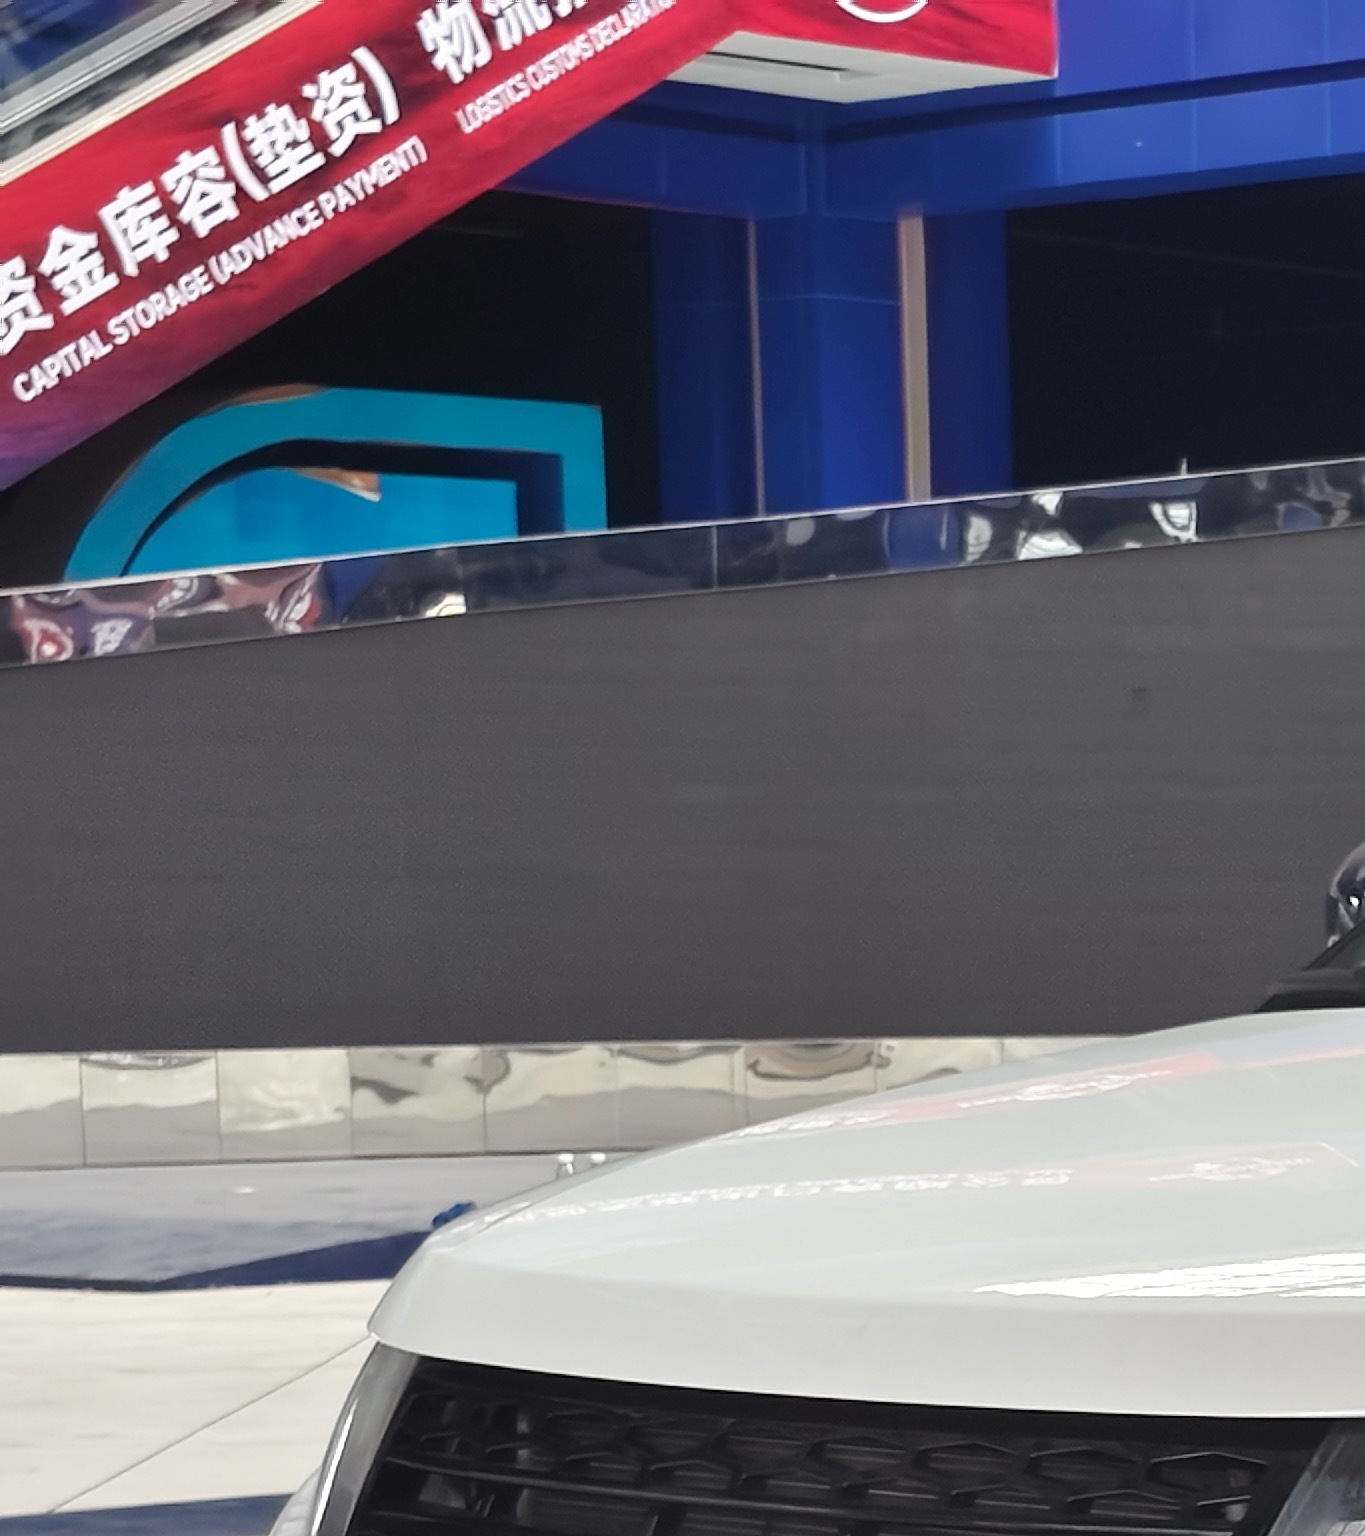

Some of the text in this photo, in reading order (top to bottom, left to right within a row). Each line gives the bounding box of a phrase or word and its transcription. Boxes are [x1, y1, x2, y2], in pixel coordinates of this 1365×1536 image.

[416, 0, 588, 84] 物流
[12, 135, 429, 403] CAPITAL STORAGE (ADVANCE PAYMENT)
